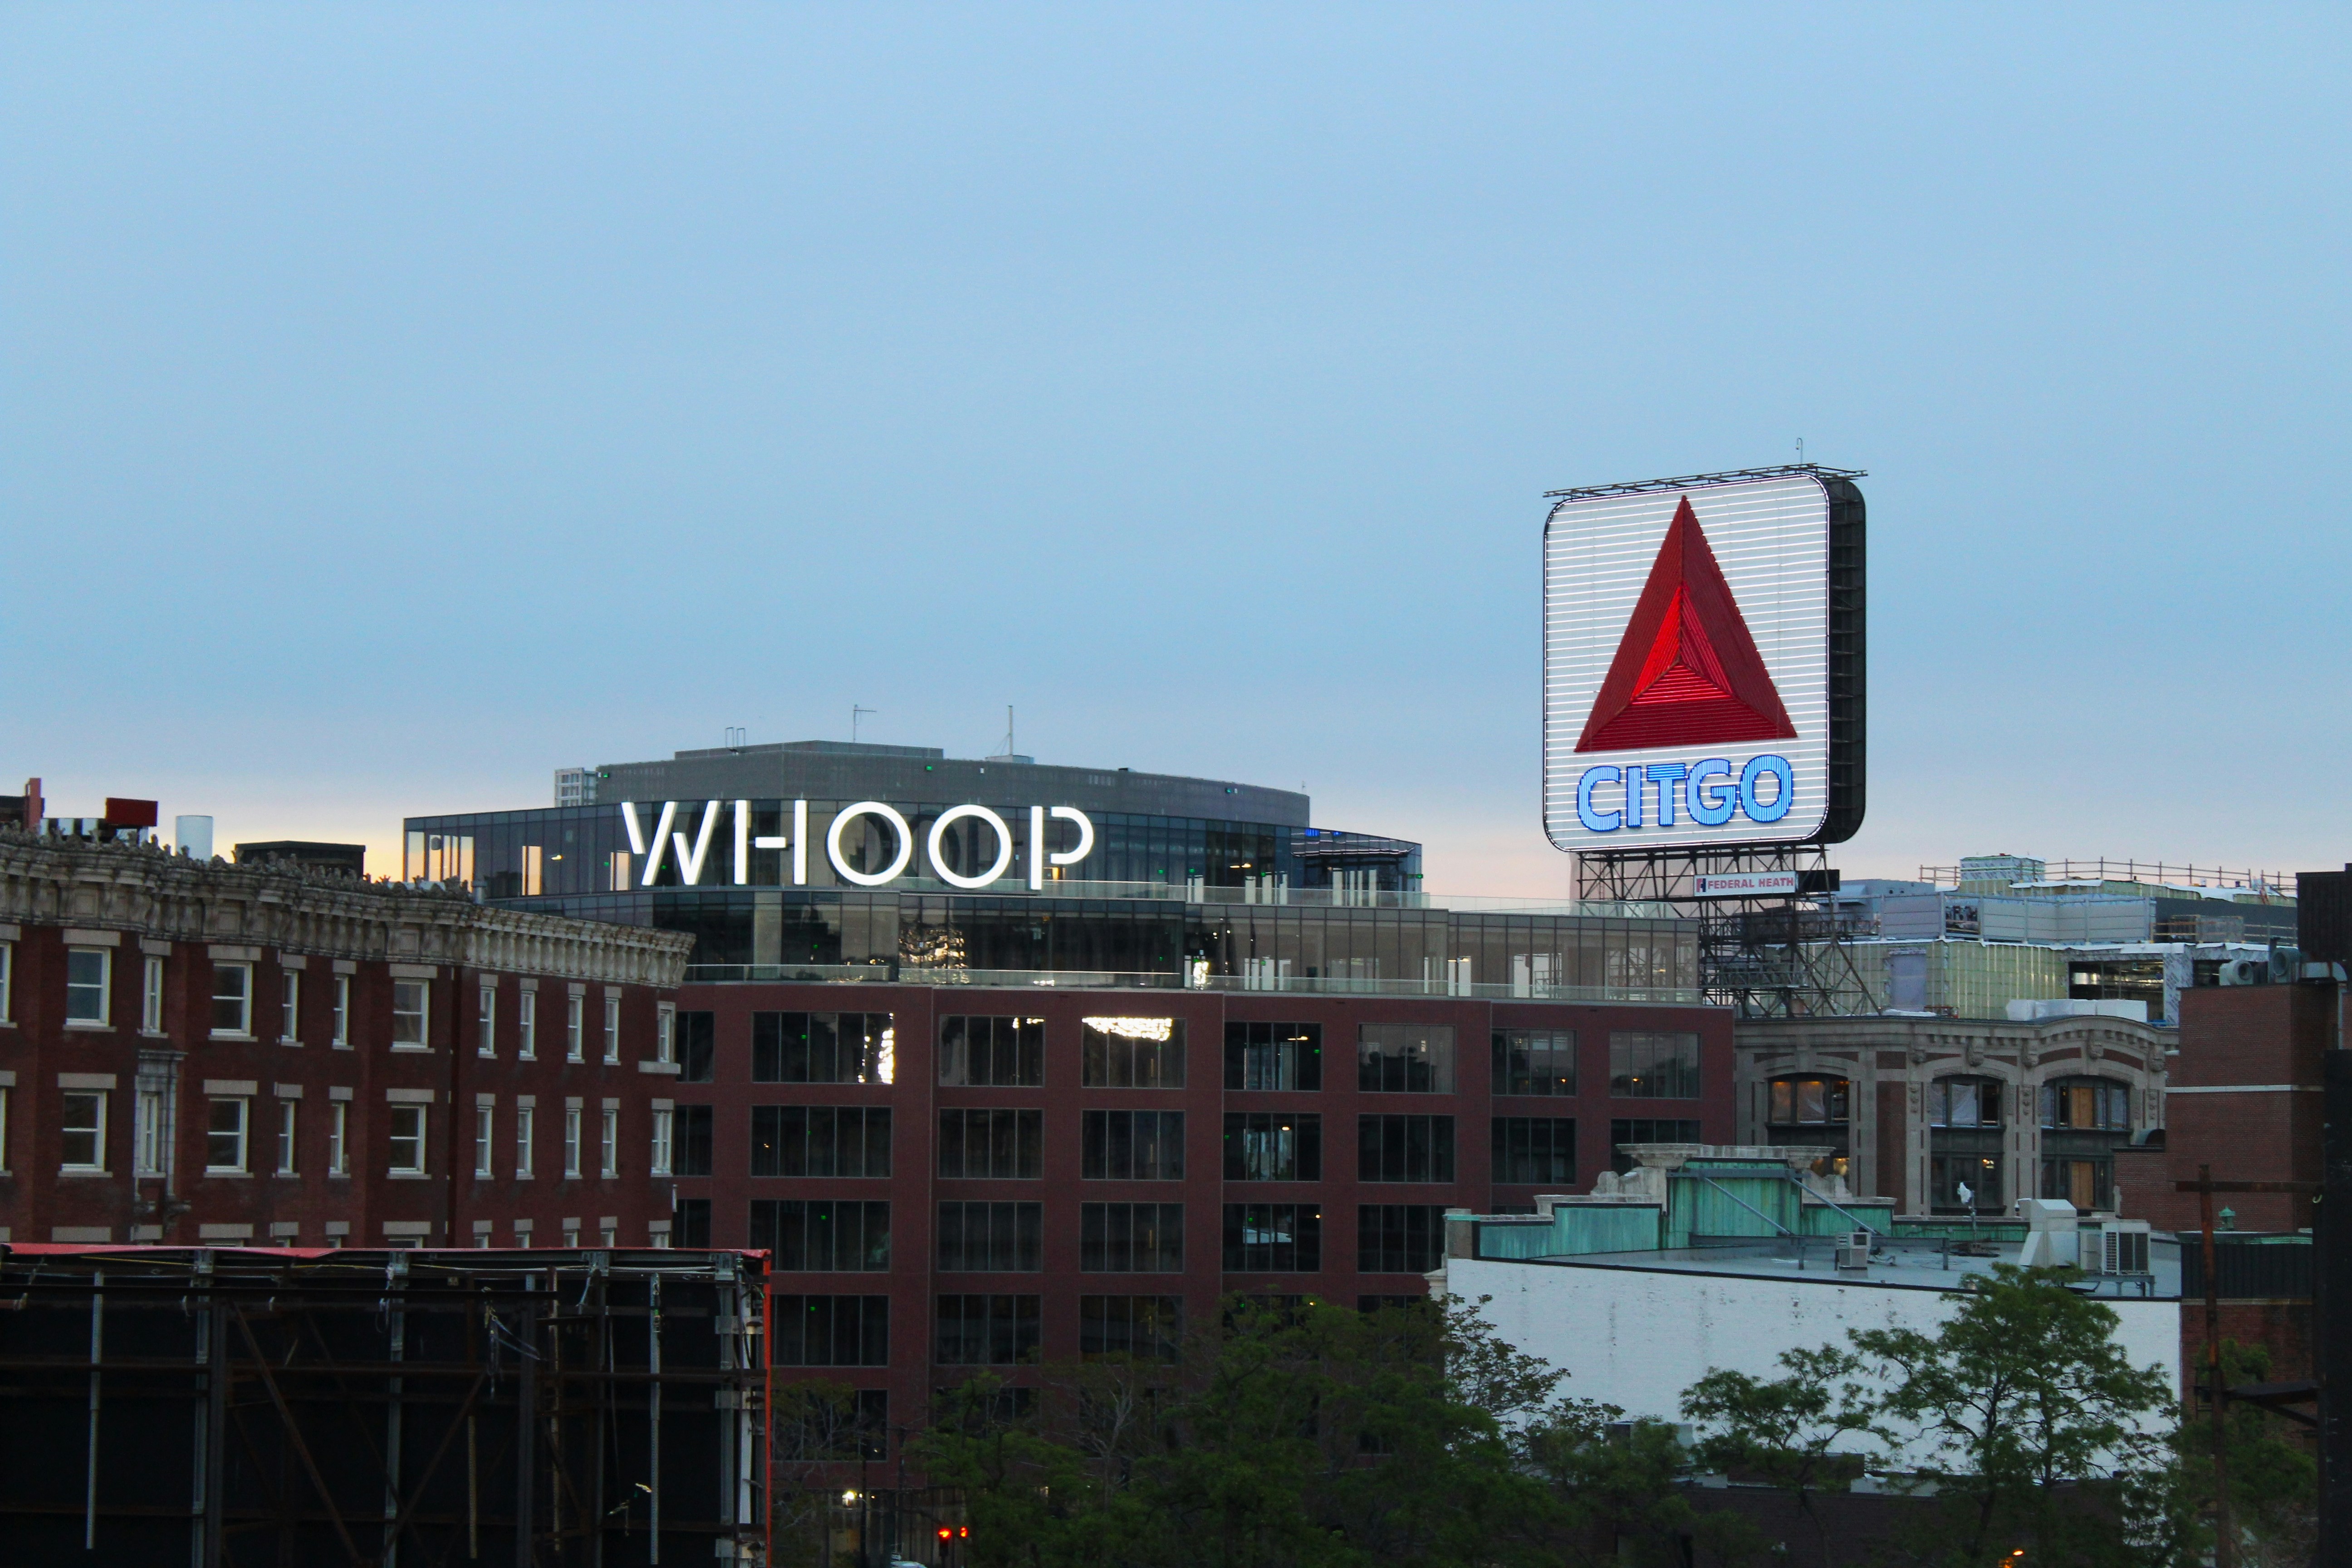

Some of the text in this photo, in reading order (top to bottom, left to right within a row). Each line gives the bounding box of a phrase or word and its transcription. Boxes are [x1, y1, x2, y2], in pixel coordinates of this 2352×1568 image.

[1577, 755, 1794, 832] CITGO
[622, 800, 1093, 890] WHOOP
[1708, 877, 1793, 889] FEDERAL HEATH
